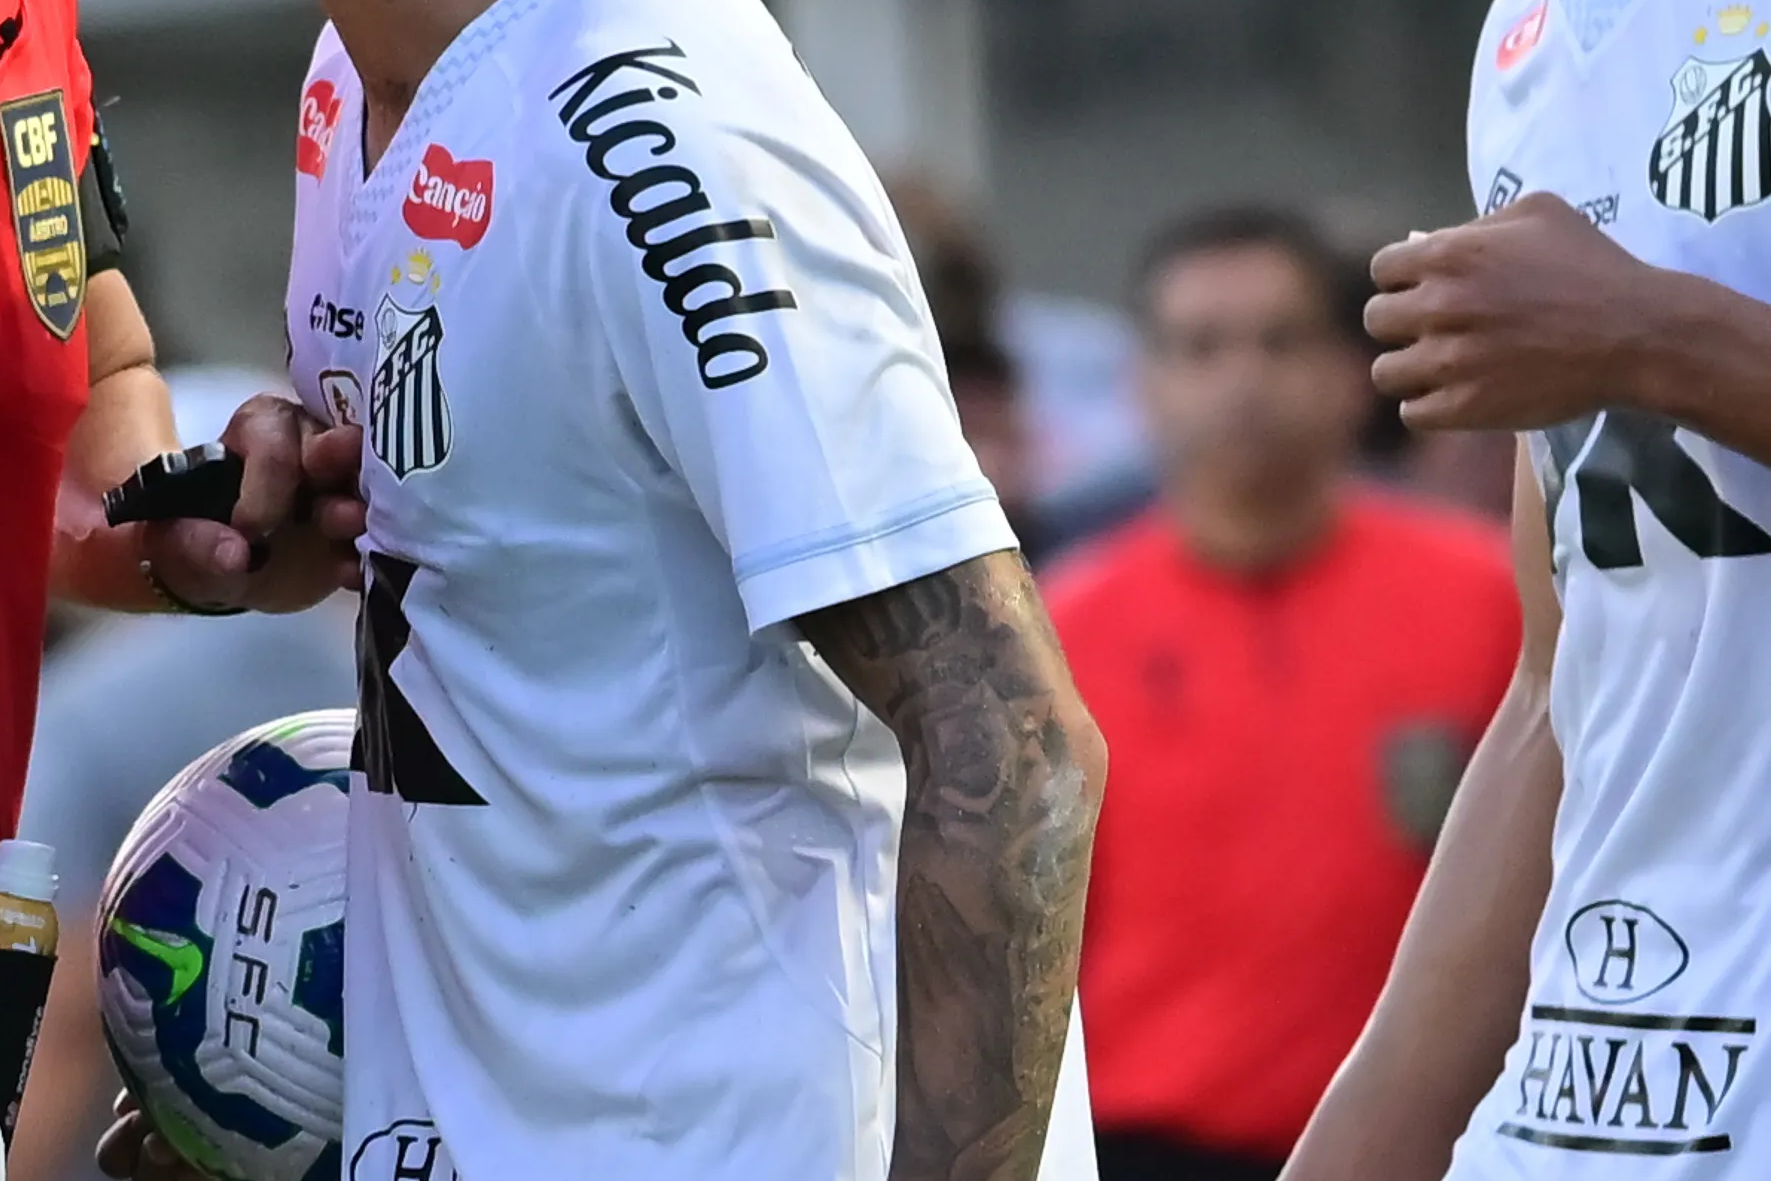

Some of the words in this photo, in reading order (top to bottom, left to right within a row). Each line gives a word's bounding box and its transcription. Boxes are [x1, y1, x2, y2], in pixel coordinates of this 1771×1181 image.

[14, 112, 58, 169] CBF
[547, 35, 799, 391] Kicaldo
[1516, 1031, 1749, 1131] HAVAN
